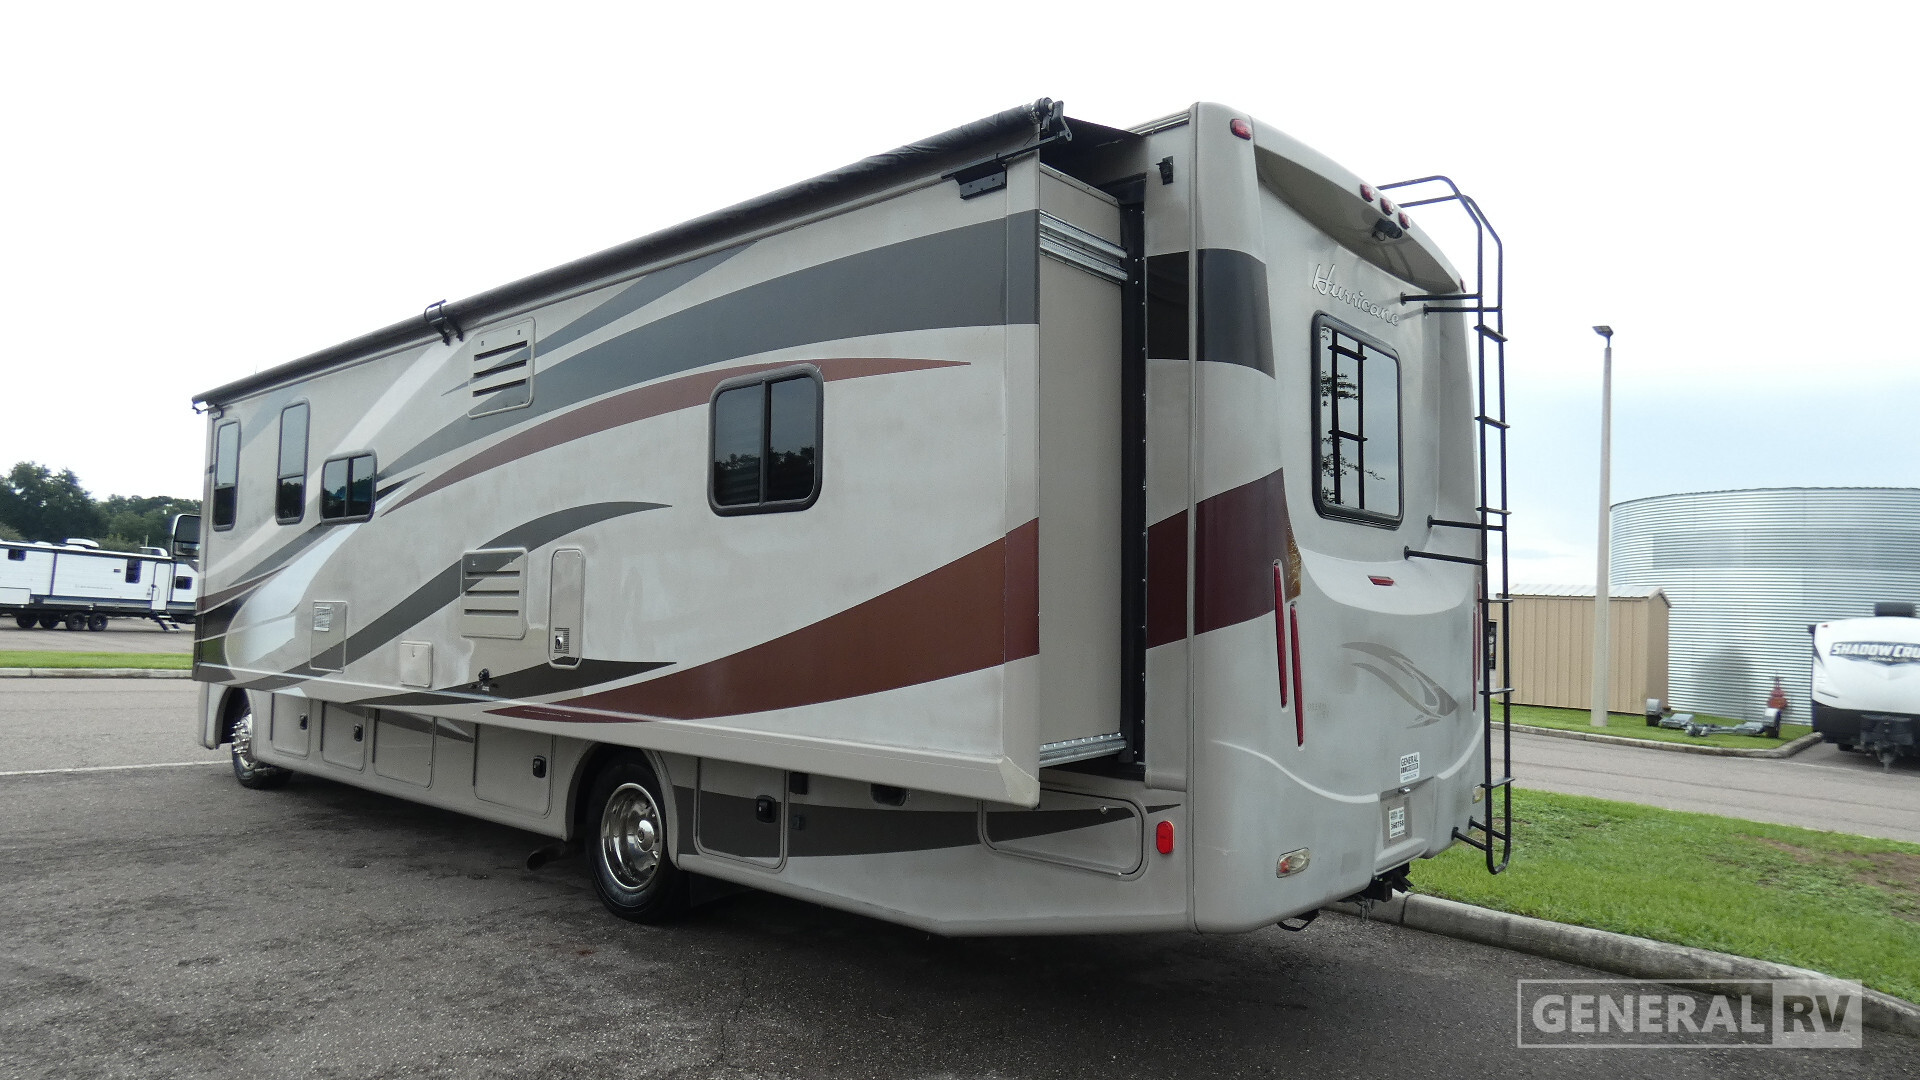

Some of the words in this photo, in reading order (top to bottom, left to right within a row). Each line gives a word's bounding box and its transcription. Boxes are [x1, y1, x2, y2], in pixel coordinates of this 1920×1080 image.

[1312, 263, 1399, 326] Hurricane
[1831, 643, 1892, 656] SHADOW
[1401, 755, 1418, 767] GENERAL
